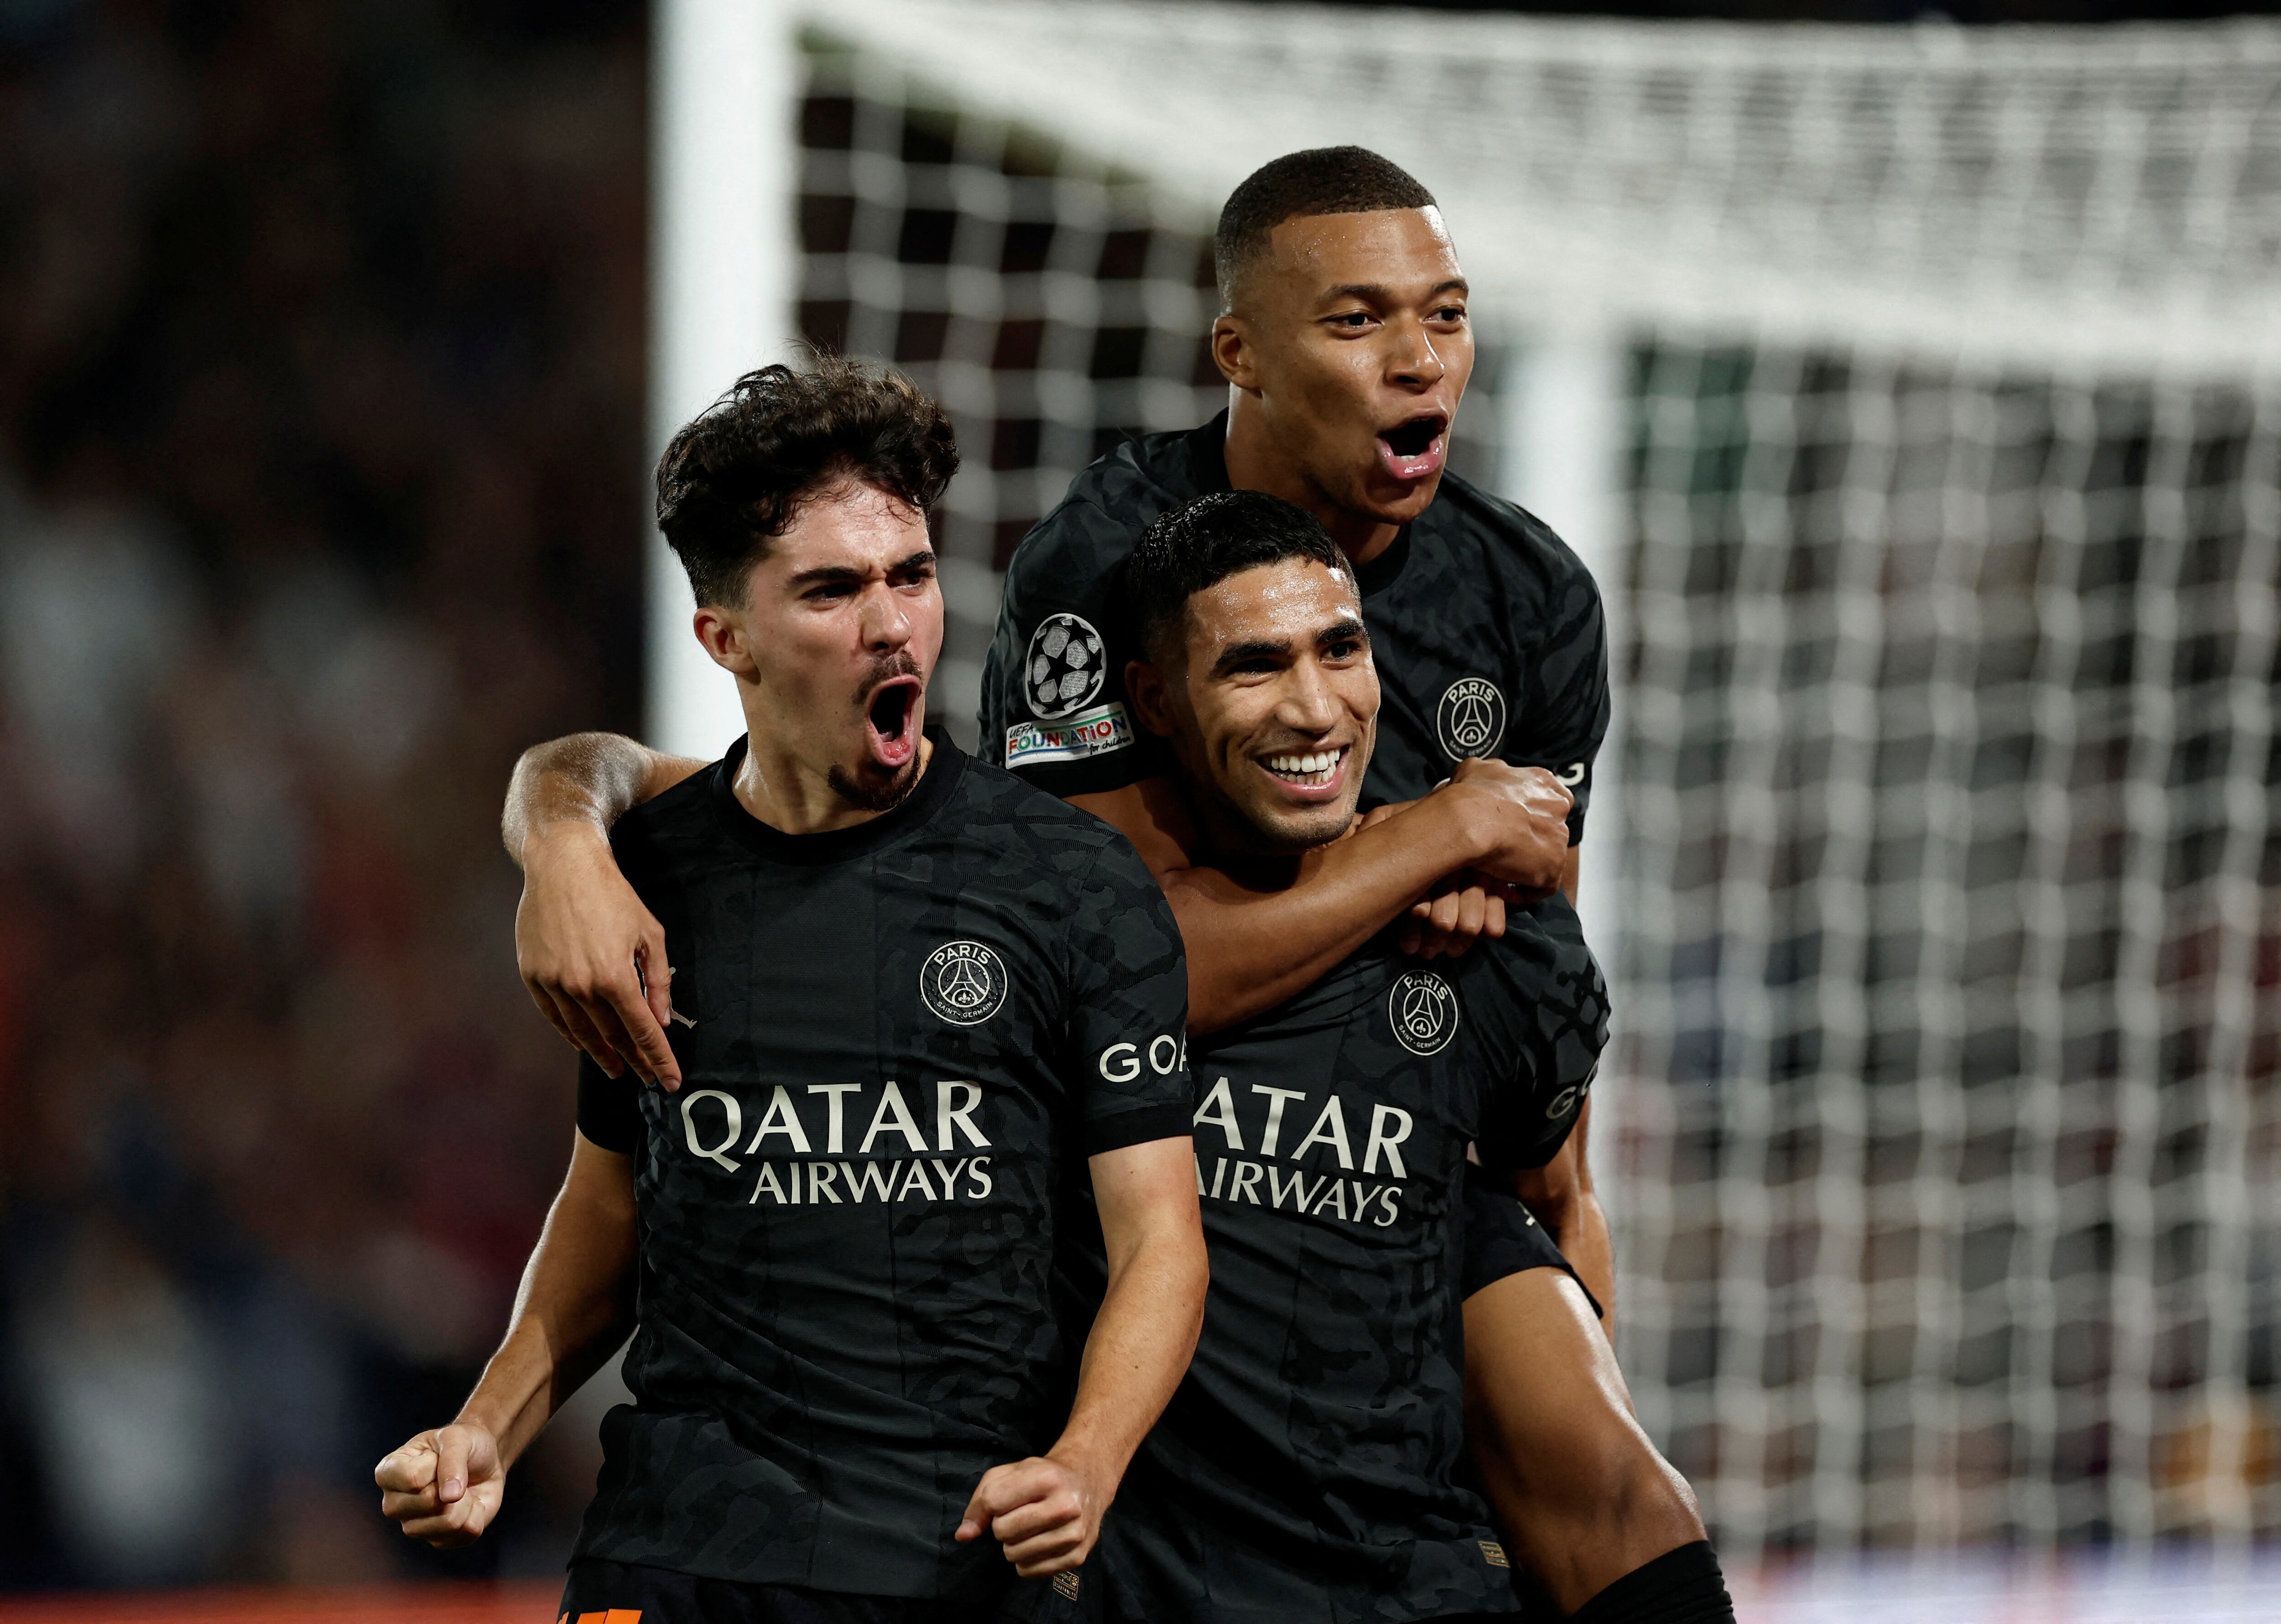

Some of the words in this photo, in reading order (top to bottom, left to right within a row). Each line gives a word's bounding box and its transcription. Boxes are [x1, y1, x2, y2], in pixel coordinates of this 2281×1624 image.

[1448, 682, 1495, 704] PARIS
[1009, 724, 1035, 738] UEFA
[1090, 744, 1099, 755] for
[1102, 735, 1130, 749] children
[934, 945, 991, 966] PARIS
[1404, 974, 1448, 1000] PARIS
[681, 1081, 992, 1173] QATAR
[1193, 1076, 1413, 1179] ATAR
[749, 1156, 992, 1204] AIRWAYS
